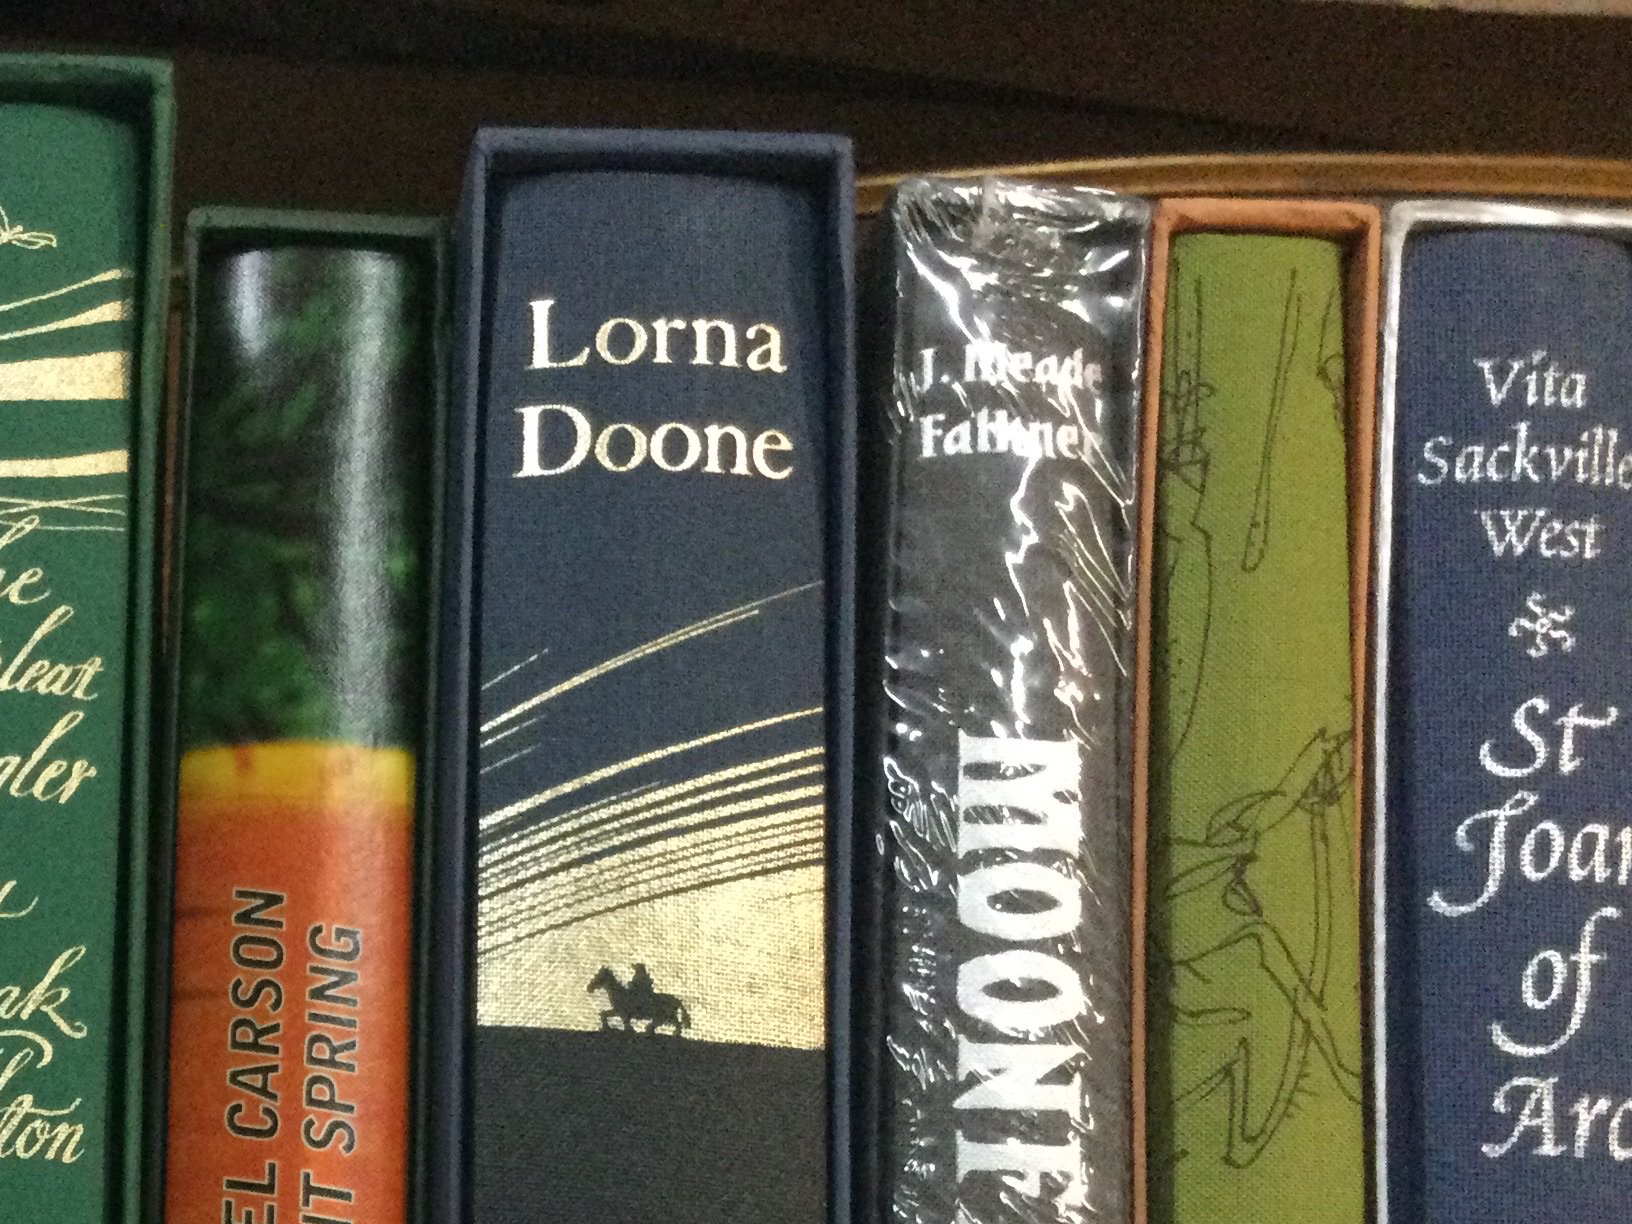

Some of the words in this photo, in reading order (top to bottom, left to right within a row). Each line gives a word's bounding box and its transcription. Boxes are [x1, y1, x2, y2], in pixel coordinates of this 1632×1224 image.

[524, 298, 788, 374] Lorna
[1473, 349, 1587, 409] Vita
[512, 402, 794, 481] Doone
[1472, 507, 1607, 560] West
[1478, 694, 1620, 779] St
[224, 886, 287, 1142] CARSON
[1487, 906, 1624, 1059] of
[301, 922, 362, 1156] SPRING
